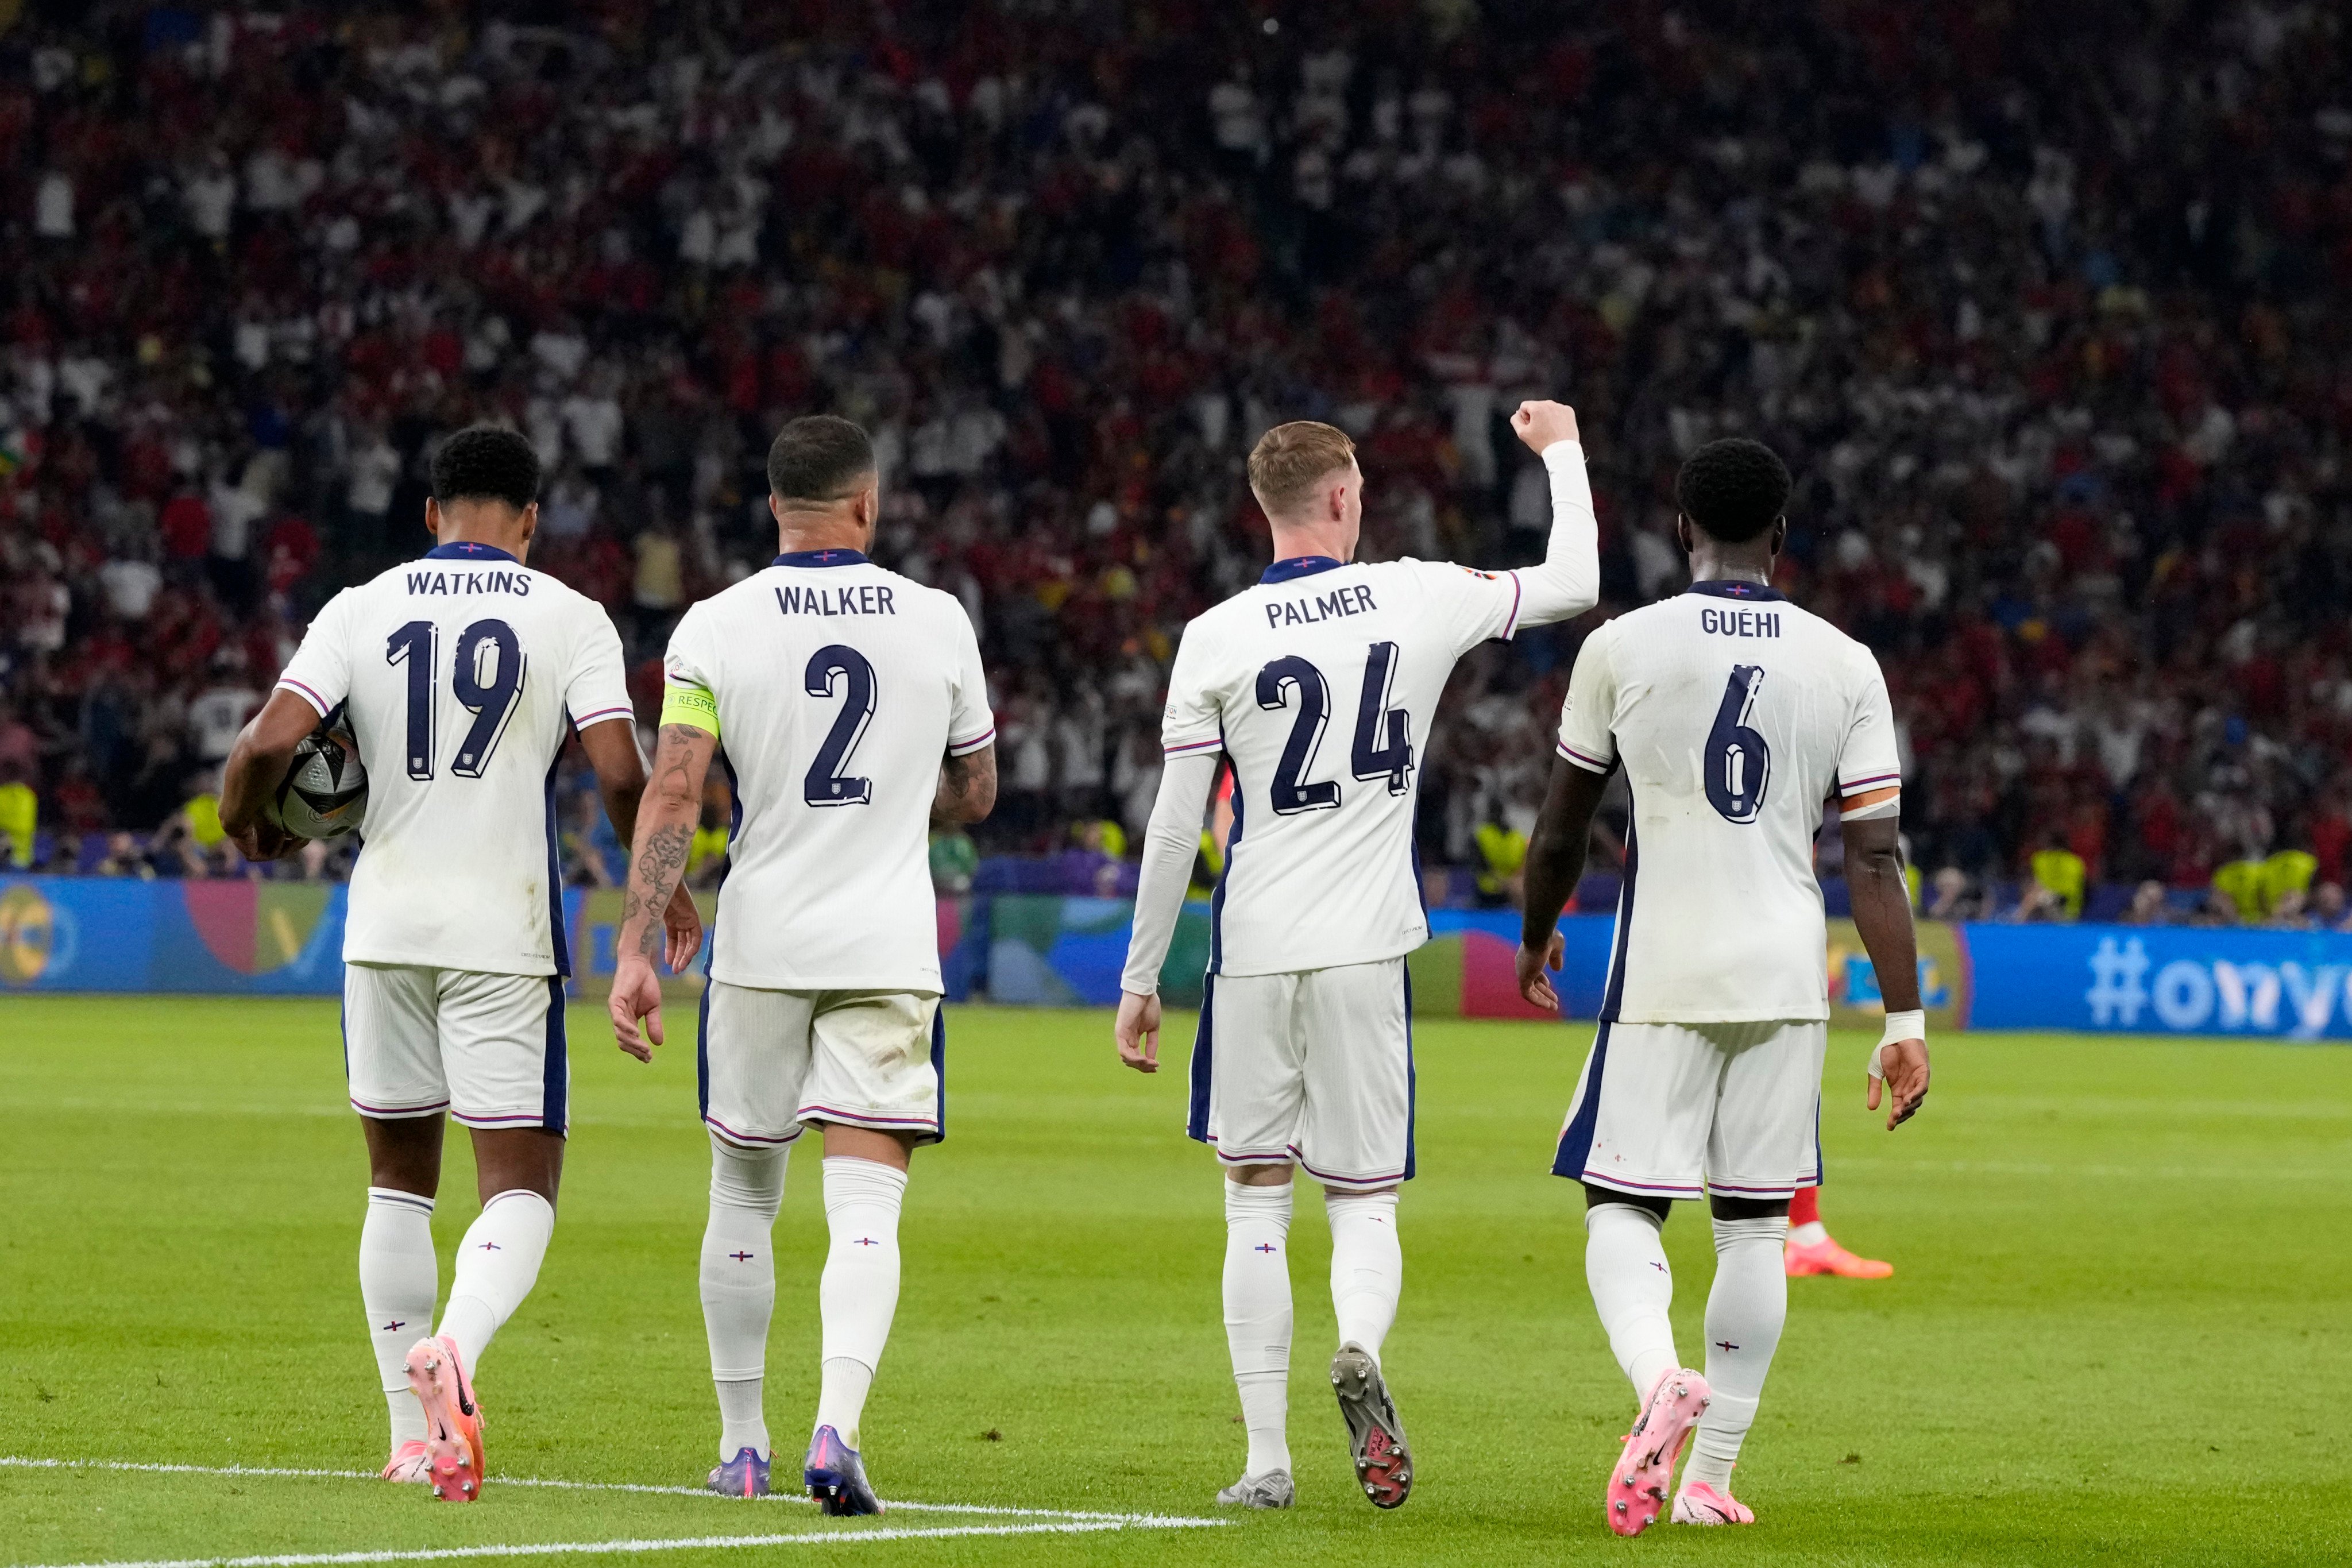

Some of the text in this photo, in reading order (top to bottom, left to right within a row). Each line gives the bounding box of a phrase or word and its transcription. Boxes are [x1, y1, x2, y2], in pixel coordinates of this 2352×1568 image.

[407, 571, 532, 596] WATKINS
[775, 586, 895, 616] WALKER
[1265, 584, 1377, 628] PALMER
[1701, 608, 1780, 638] GUÉHI
[387, 619, 527, 781] 19
[678, 695, 717, 716] RESPEC
[804, 644, 878, 808] 2
[1255, 641, 1415, 816] 24
[1704, 664, 1771, 824] 6
